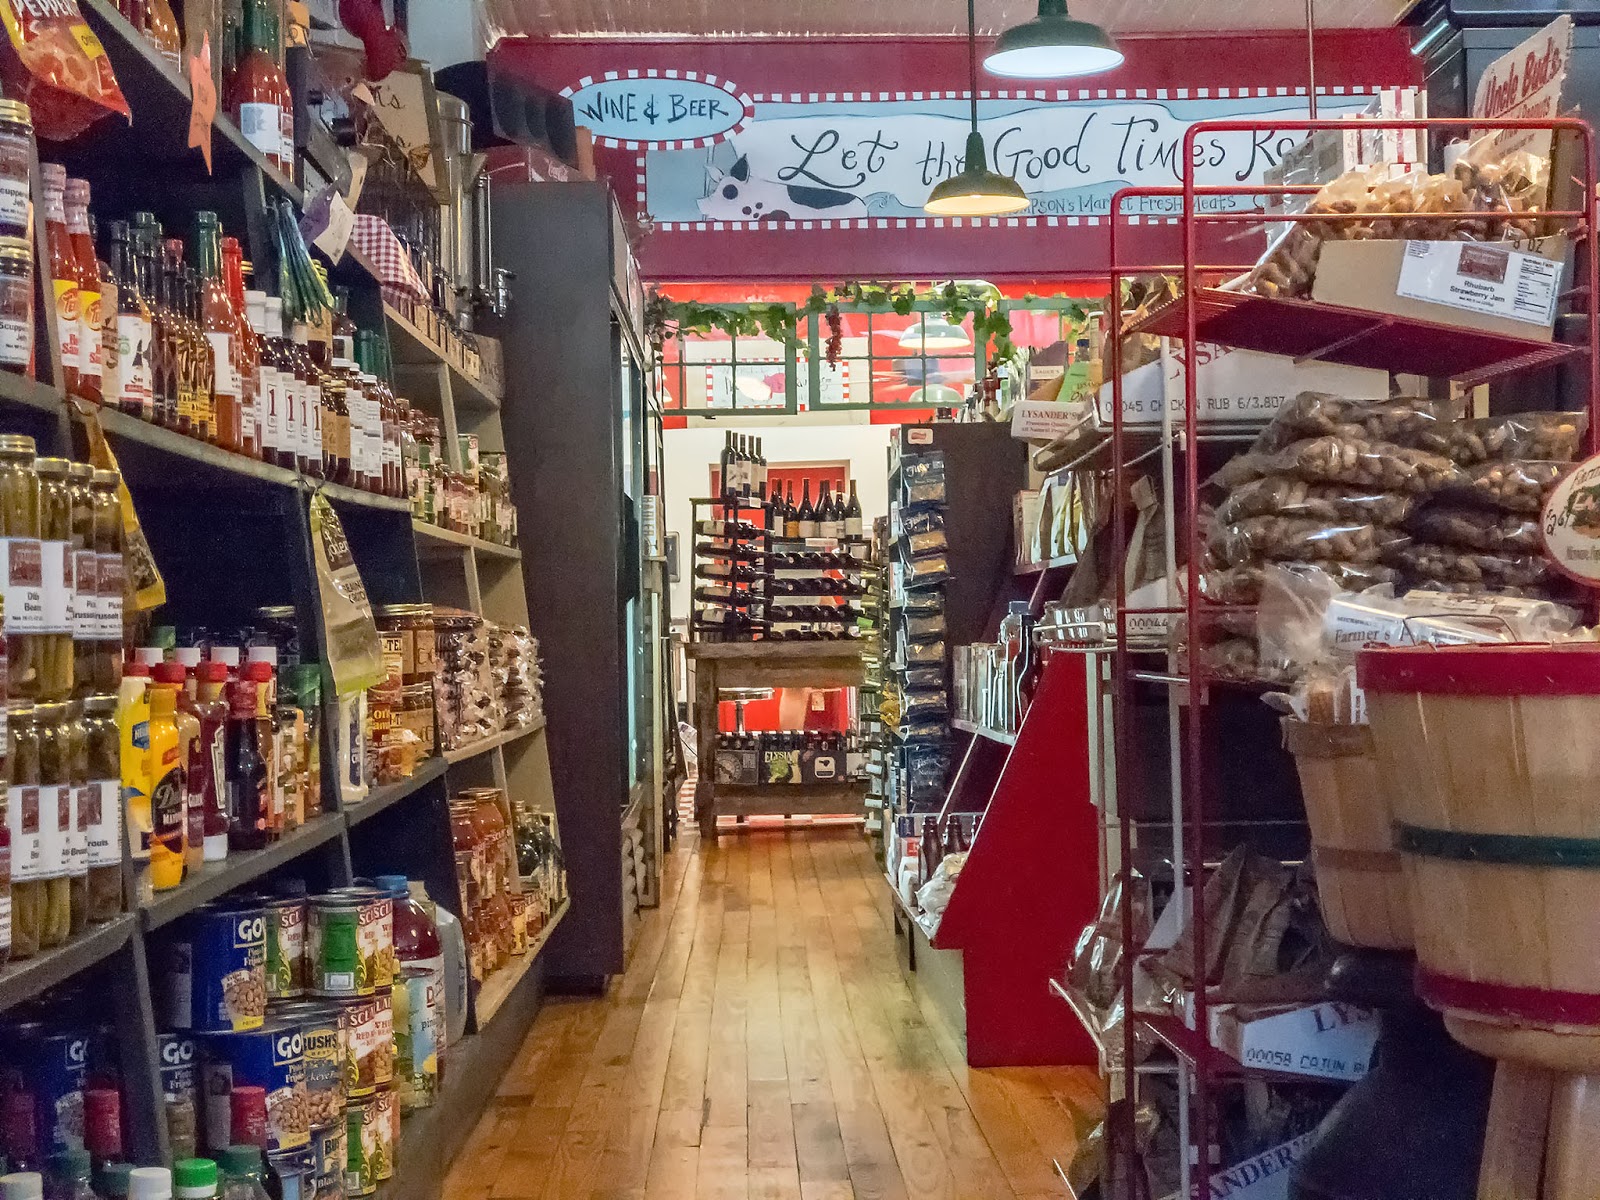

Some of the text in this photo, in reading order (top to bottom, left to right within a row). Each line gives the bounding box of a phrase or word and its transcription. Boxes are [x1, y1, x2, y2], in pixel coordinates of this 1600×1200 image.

[1484, 36, 1562, 119] Uncle Bud's
[578, 91, 730, 125] WINE & BEER
[777, 129, 899, 188] Let
[992, 112, 1099, 179] Good
[1449, 285, 1506, 303] Strawberry Jam
[1463, 280, 1496, 293] Rhubarb
[1105, 401, 1144, 413] 0045
[1150, 398, 1201, 412] CHCKN
[1207, 396, 1230, 410] RUB
[1021, 409, 1078, 421] LYSANDER'S
